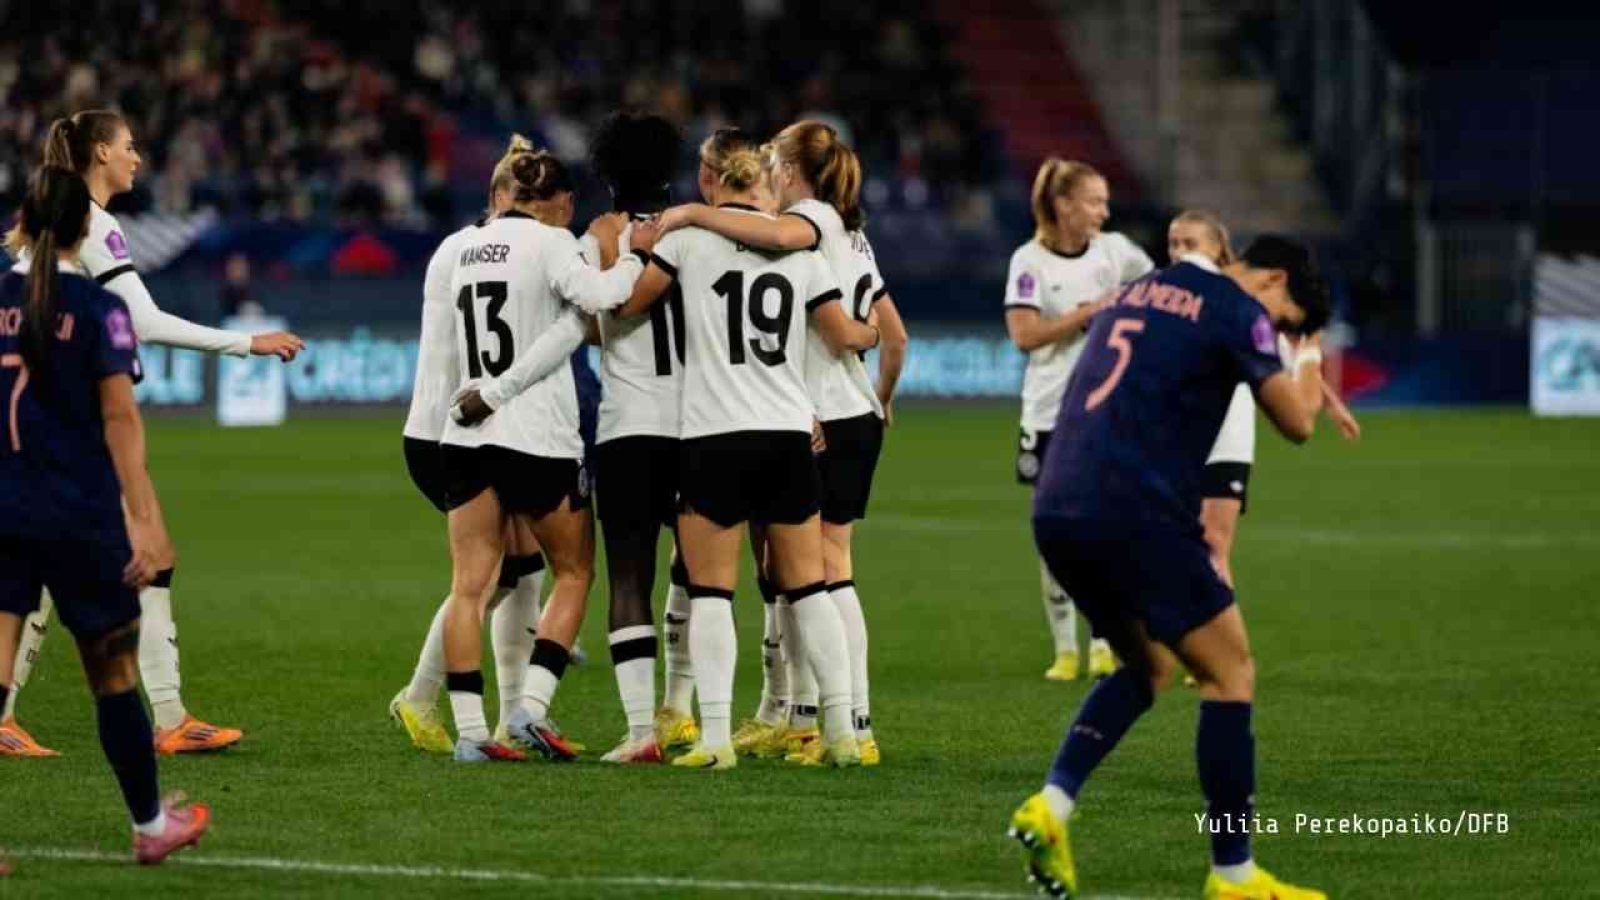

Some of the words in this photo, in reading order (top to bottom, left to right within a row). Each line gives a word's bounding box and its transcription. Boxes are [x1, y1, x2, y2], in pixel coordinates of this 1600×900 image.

[460, 243, 511, 267] WAMSER
[456, 280, 515, 379] 13
[711, 269, 794, 367] 19
[1084, 318, 1146, 411] 5
[0, 353, 30, 453] 7
